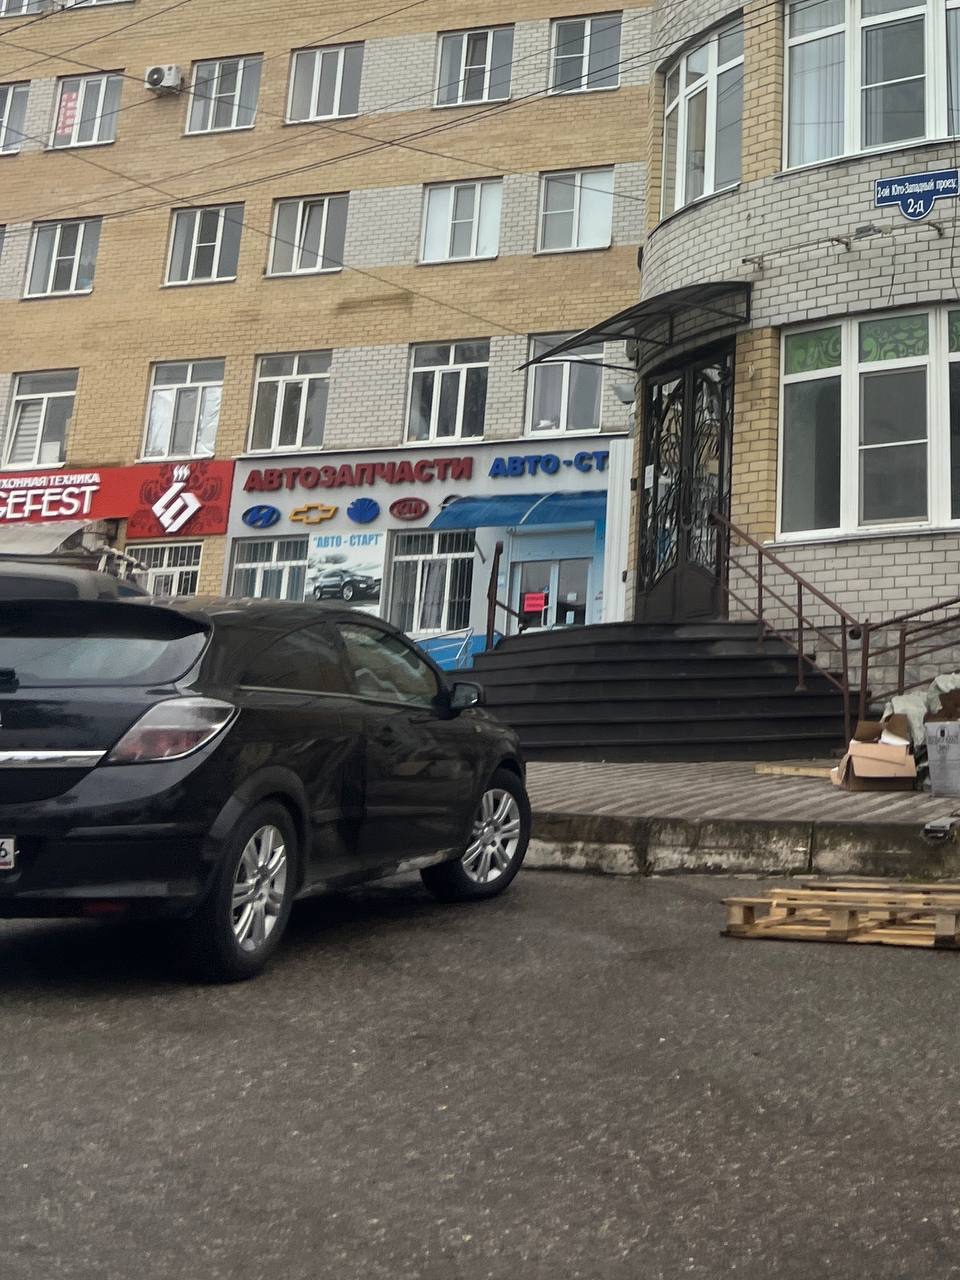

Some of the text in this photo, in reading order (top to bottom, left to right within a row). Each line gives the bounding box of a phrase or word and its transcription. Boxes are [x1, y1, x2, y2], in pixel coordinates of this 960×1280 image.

[0, 473, 101, 488] ХОННАЯ ТЕХНИКА
[243, 456, 474, 492] АВТОЗАПЧАСТИ
[488, 451, 609, 478] АВТО-СТ
